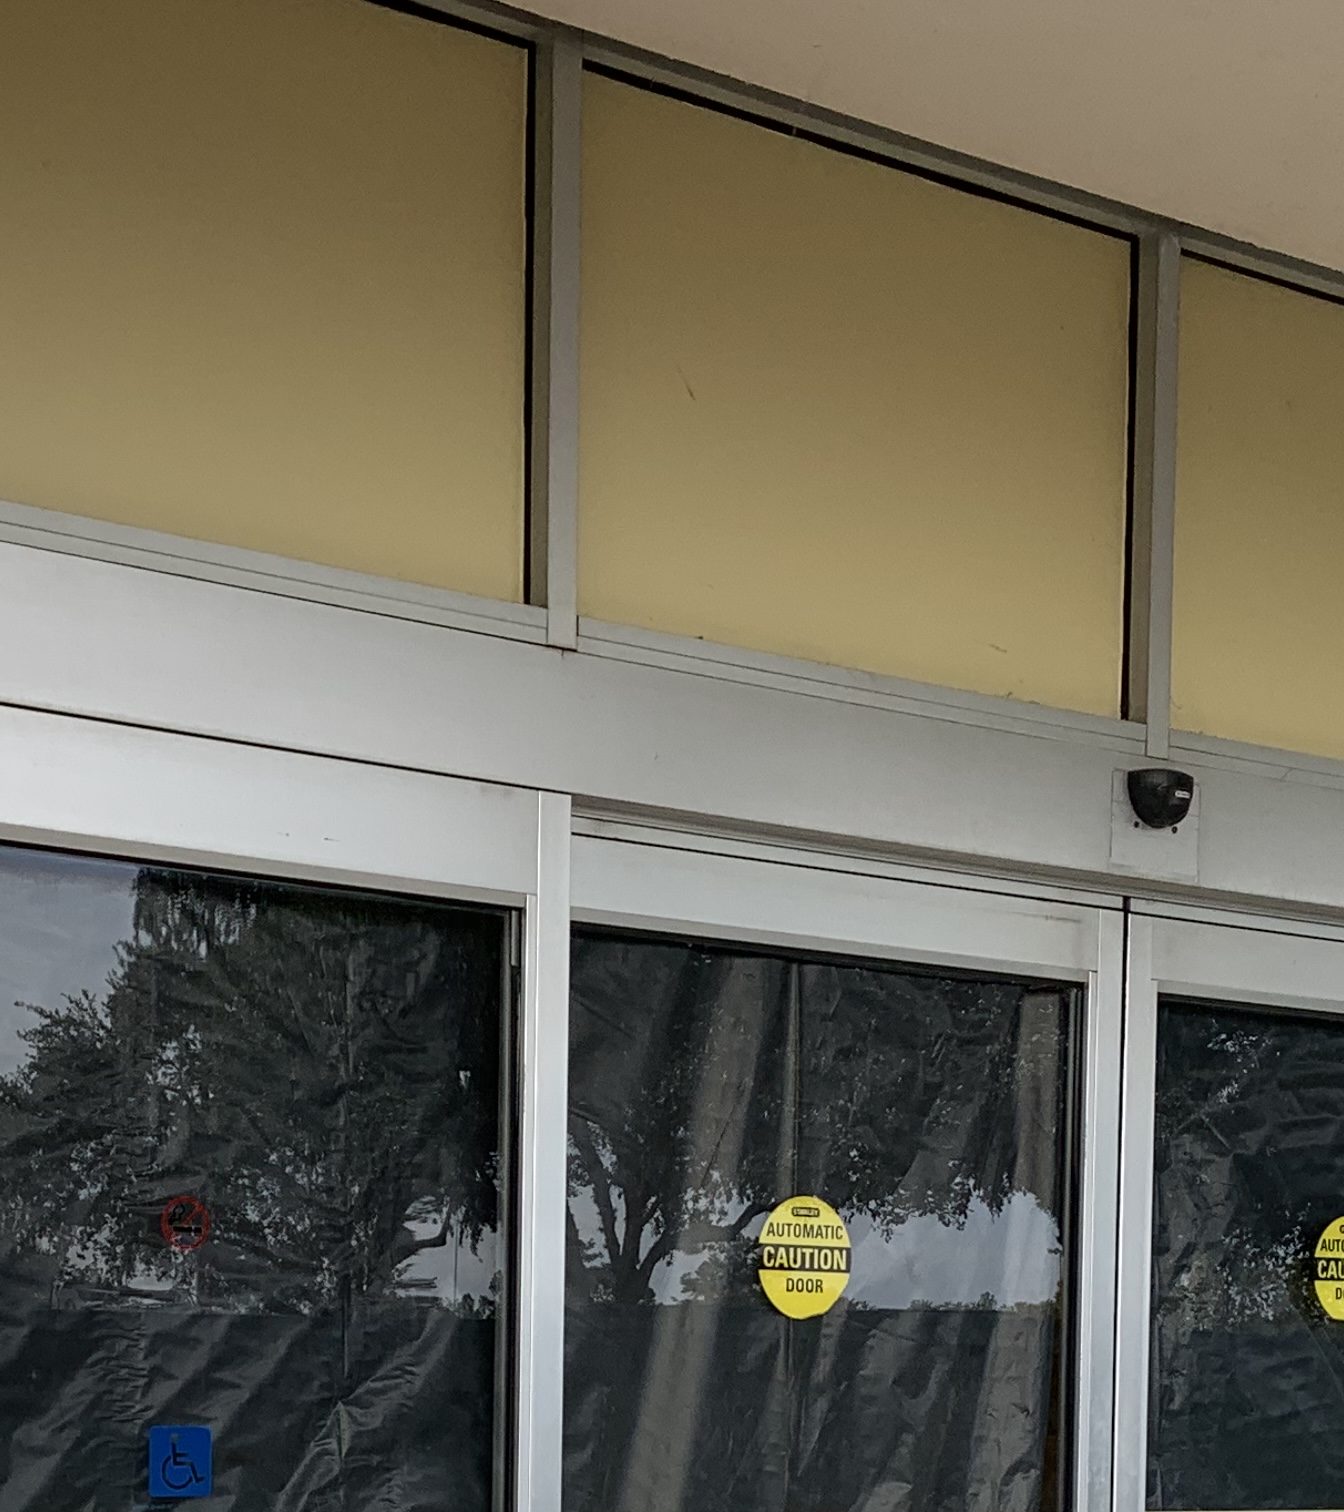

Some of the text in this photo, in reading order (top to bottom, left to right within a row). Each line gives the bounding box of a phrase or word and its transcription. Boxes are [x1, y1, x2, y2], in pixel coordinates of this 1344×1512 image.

[766, 1222, 843, 1240] AUTOMATIC
[763, 1246, 846, 1270] CAUTION
[786, 1278, 823, 1293] DOOR
